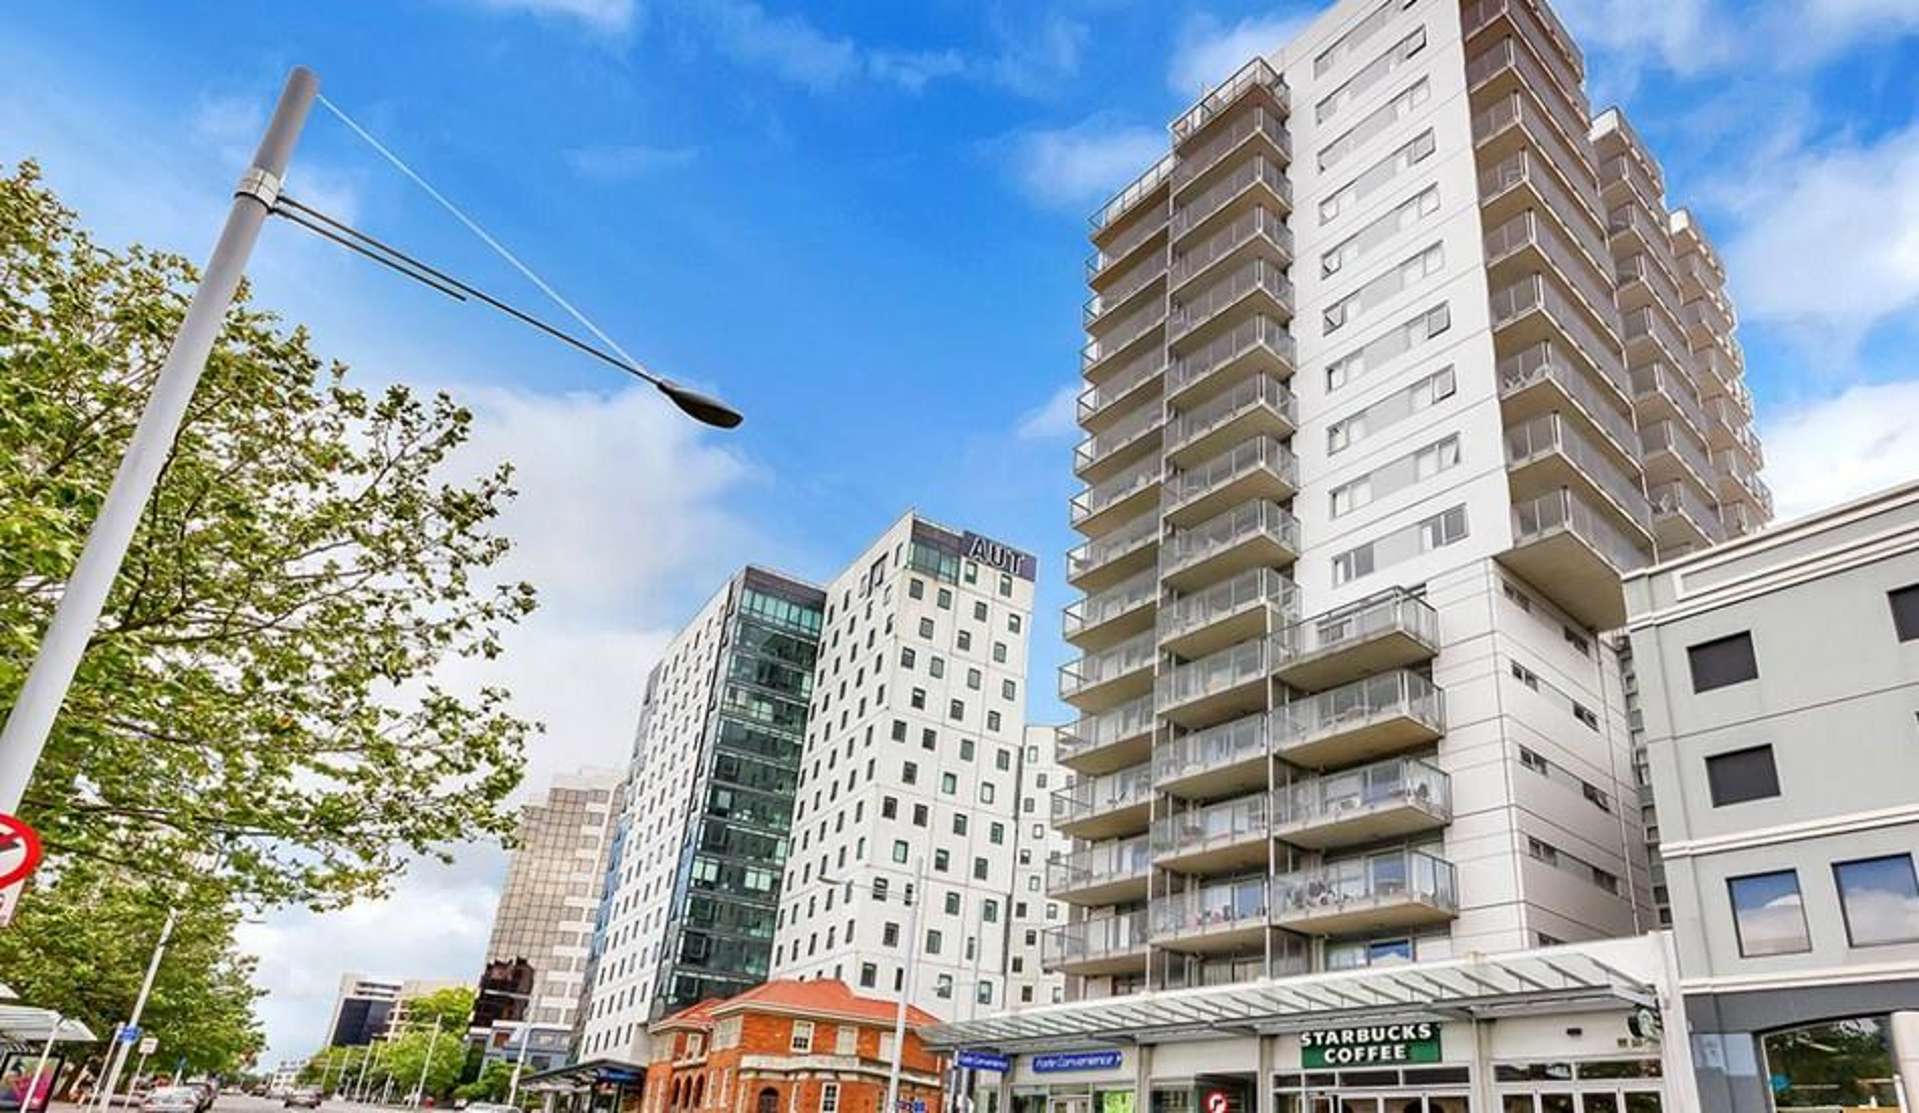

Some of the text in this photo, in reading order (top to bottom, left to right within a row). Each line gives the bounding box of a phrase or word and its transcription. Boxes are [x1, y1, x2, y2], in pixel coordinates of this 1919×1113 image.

[968, 537, 1026, 574] AUT
[1300, 1023, 1432, 1047] STARBUCKS
[1324, 1045, 1407, 1064] COFFEE
